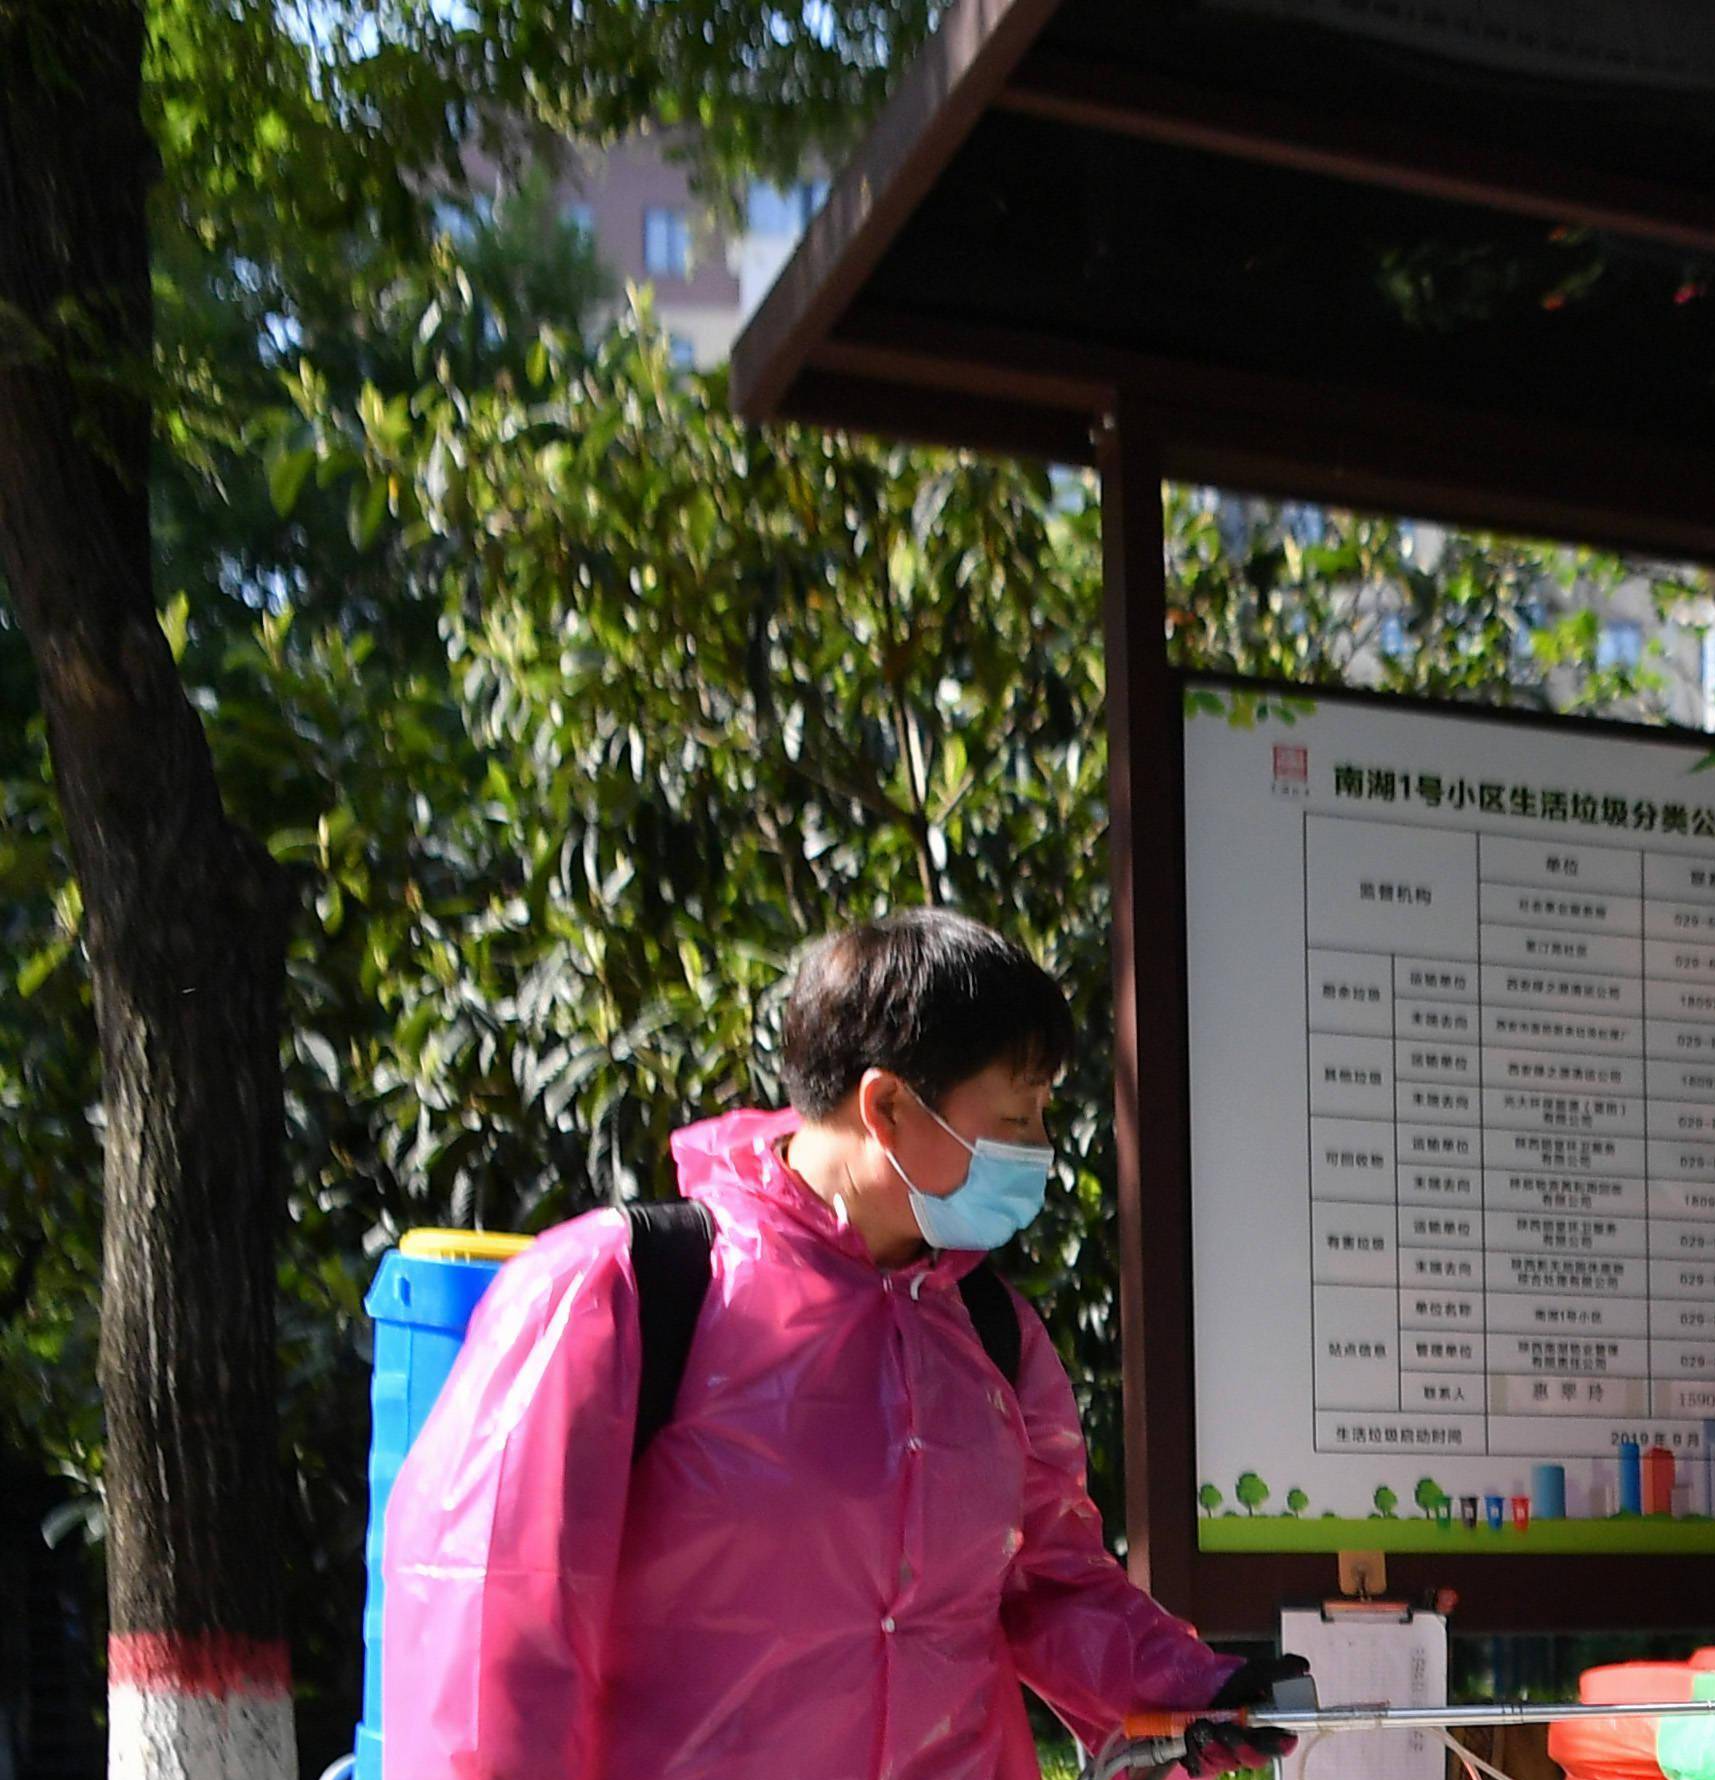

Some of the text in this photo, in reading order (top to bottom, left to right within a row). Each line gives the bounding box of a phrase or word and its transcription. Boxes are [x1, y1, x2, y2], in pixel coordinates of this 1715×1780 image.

[1546, 855, 1579, 876] 单位
[1360, 880, 1431, 906] 监督机构
[1336, 1426, 1463, 1445] 生活垃圾启动时间
